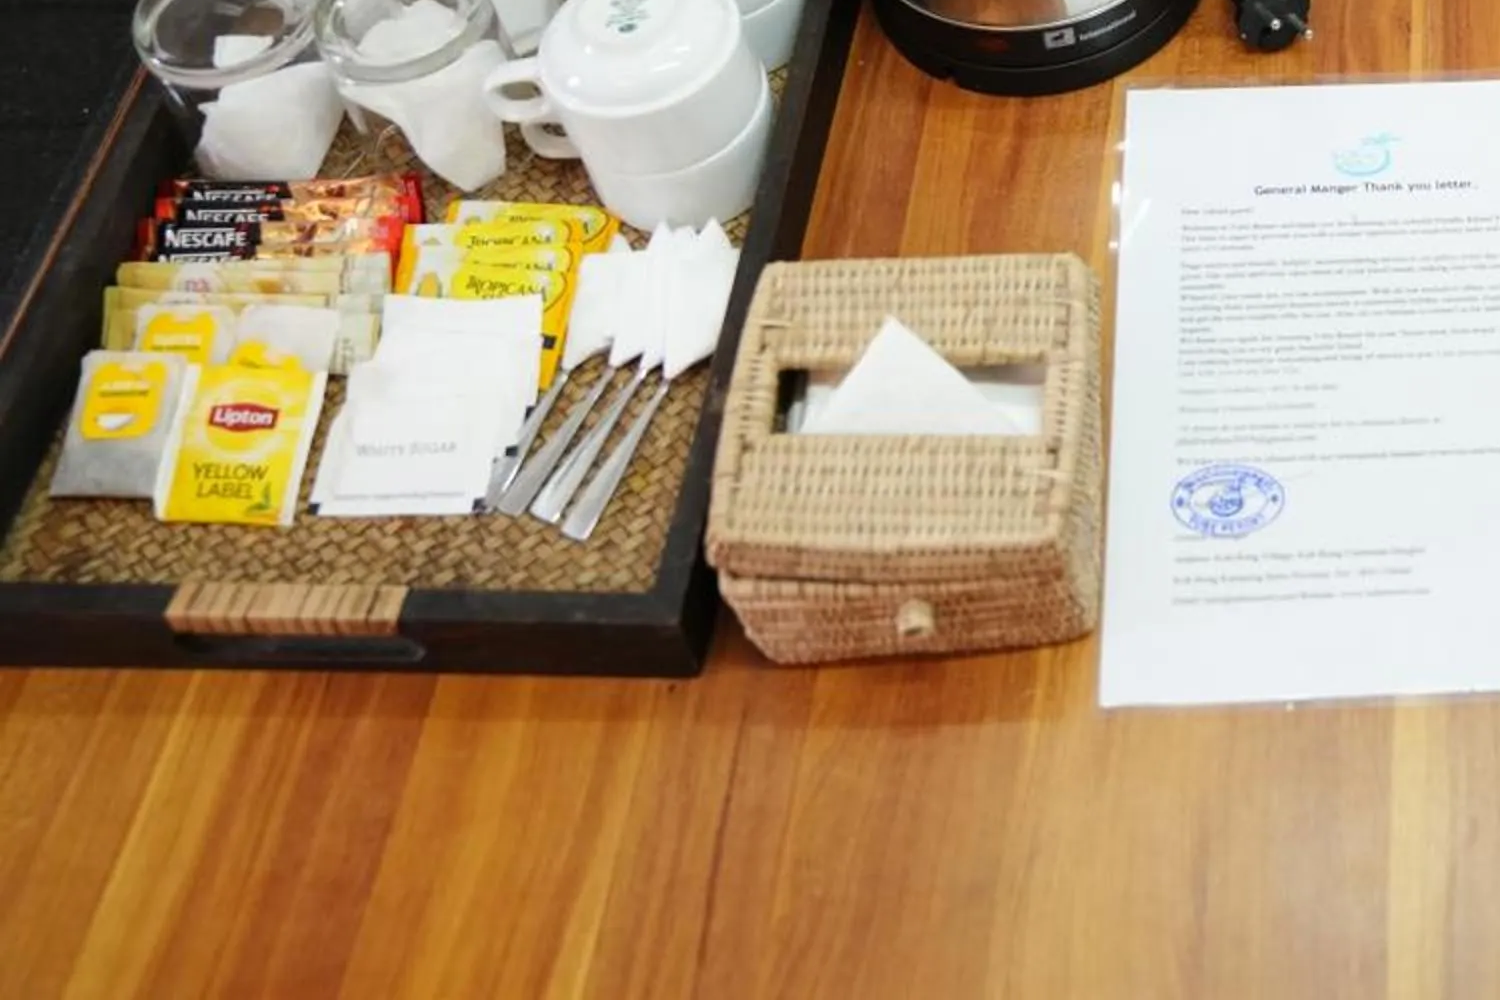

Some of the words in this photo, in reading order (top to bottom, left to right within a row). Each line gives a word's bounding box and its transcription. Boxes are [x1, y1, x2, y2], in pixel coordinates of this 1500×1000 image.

[1254, 183, 1307, 197] General
[1310, 182, 1357, 197] Manger
[1363, 180, 1402, 193] Thank
[1406, 181, 1432, 195] you
[212, 406, 274, 428] Lipton
[194, 462, 269, 482] YELLOW
[196, 481, 255, 501] LABEL
